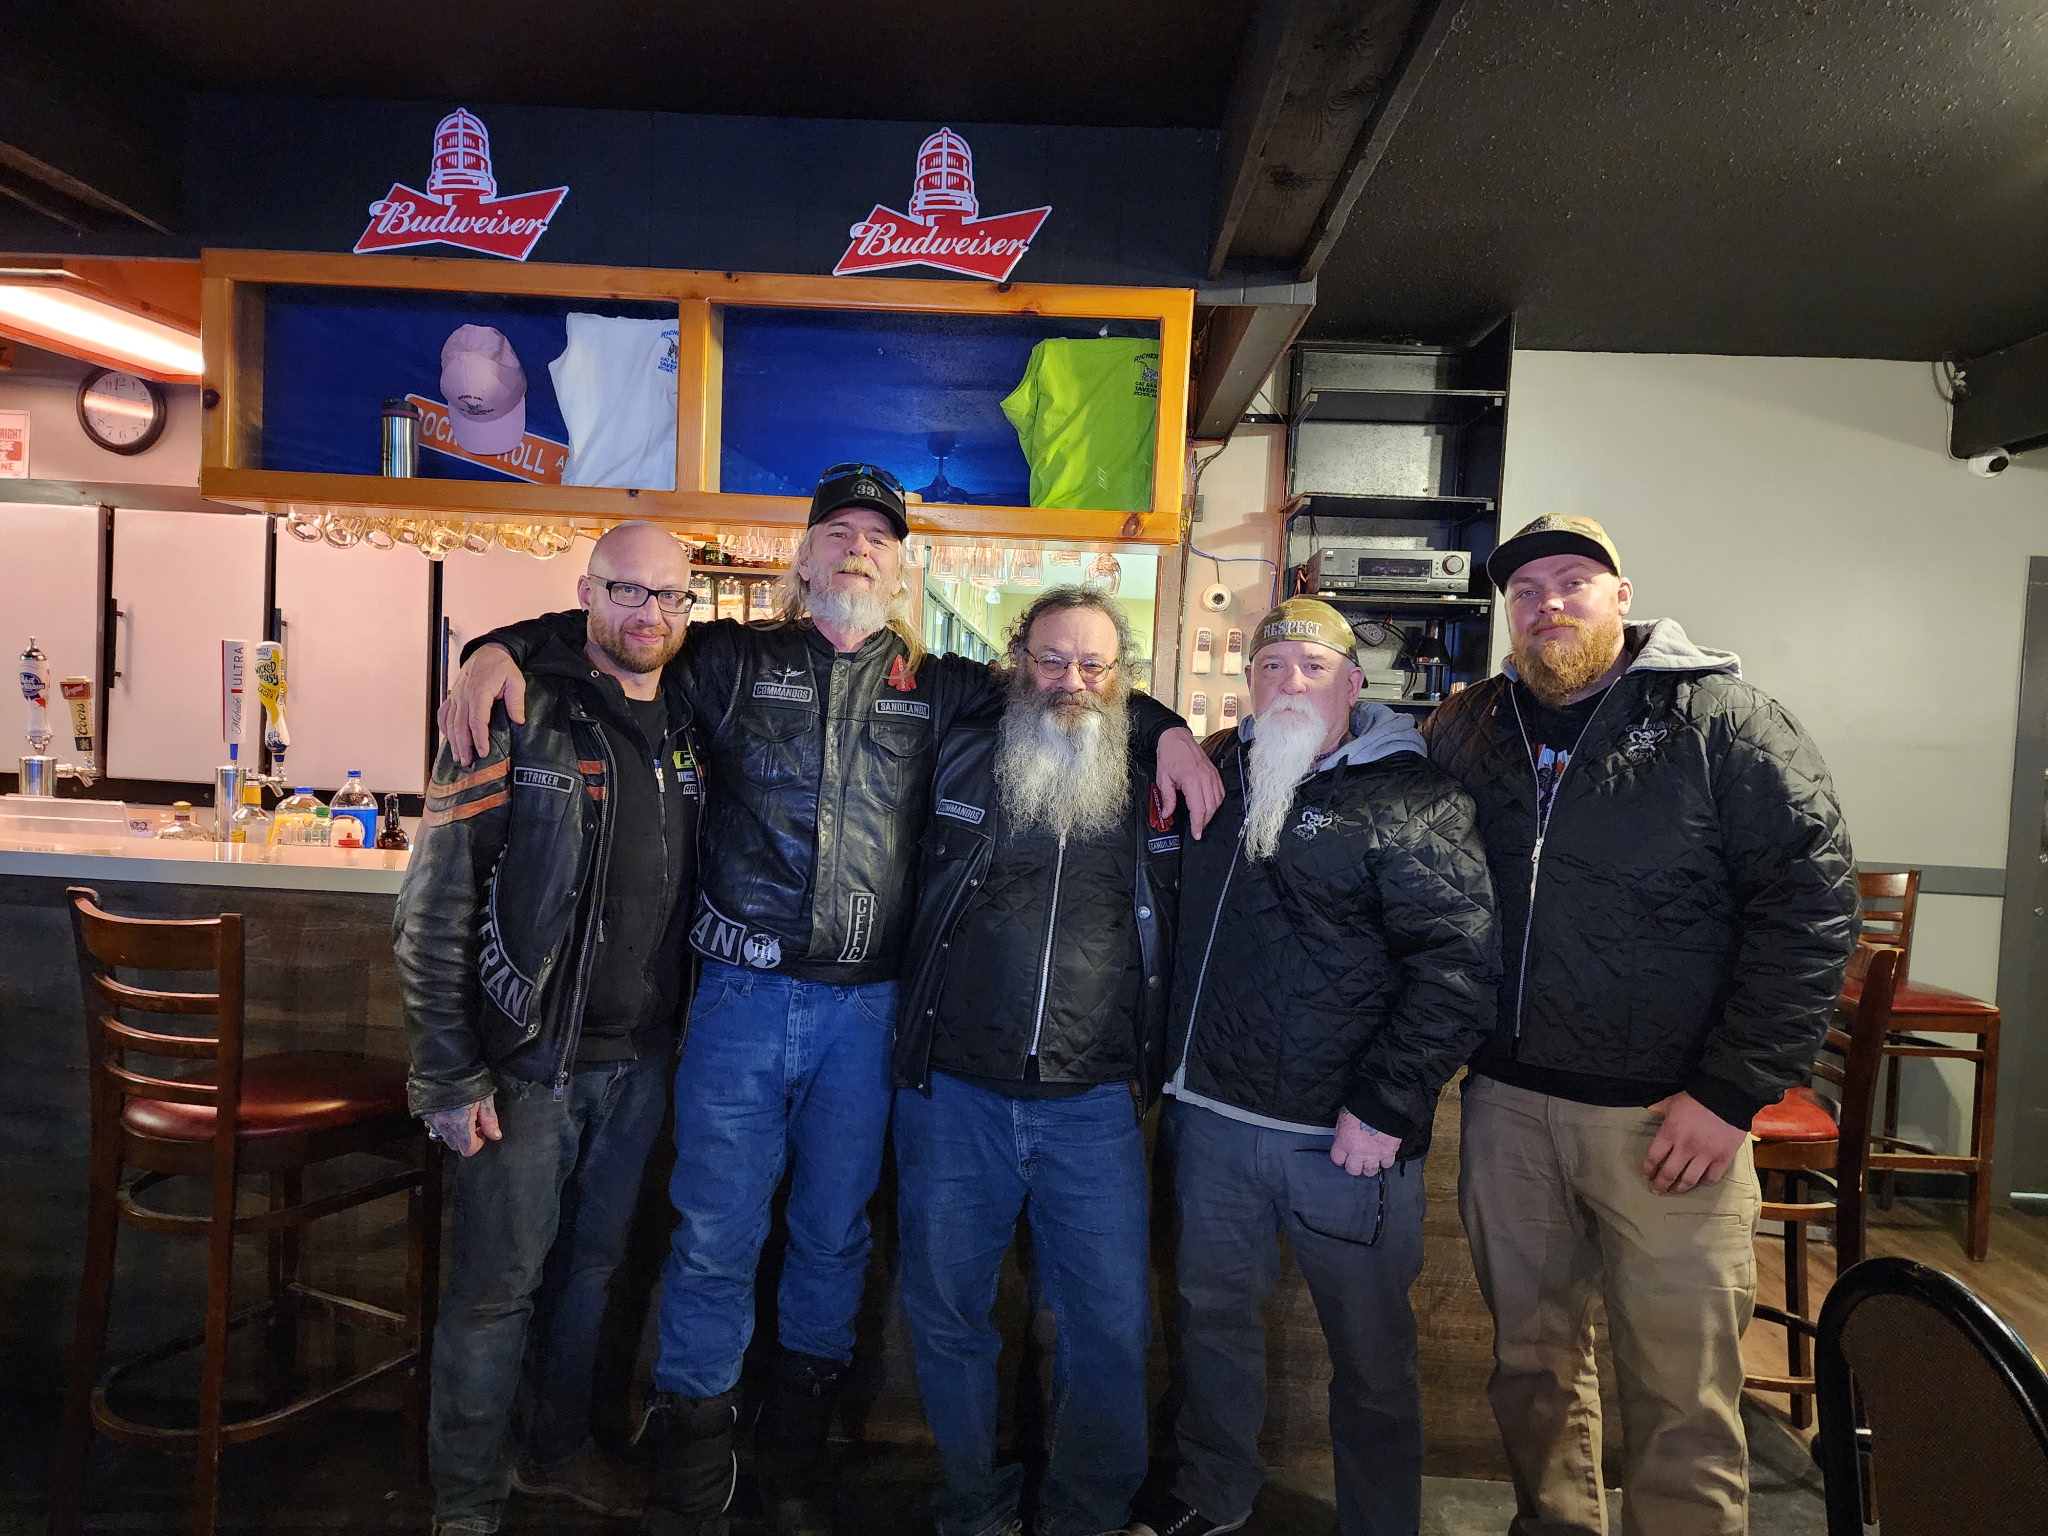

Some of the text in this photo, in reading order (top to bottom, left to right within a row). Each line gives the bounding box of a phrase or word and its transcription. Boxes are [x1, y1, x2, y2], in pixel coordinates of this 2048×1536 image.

[369, 201, 547, 235] Budweiser
[850, 222, 1029, 256] Budweiser
[661, 329, 679, 338] RICH
[497, 440, 545, 475] OLL
[1263, 620, 1322, 639] RESPECT
[232, 646, 244, 686] ULTRA
[756, 685, 809, 700] COMMANDOS
[880, 702, 928, 716] SANDILANDS
[522, 771, 560, 787] STRIKER
[939, 802, 981, 821] COMMANDOS
